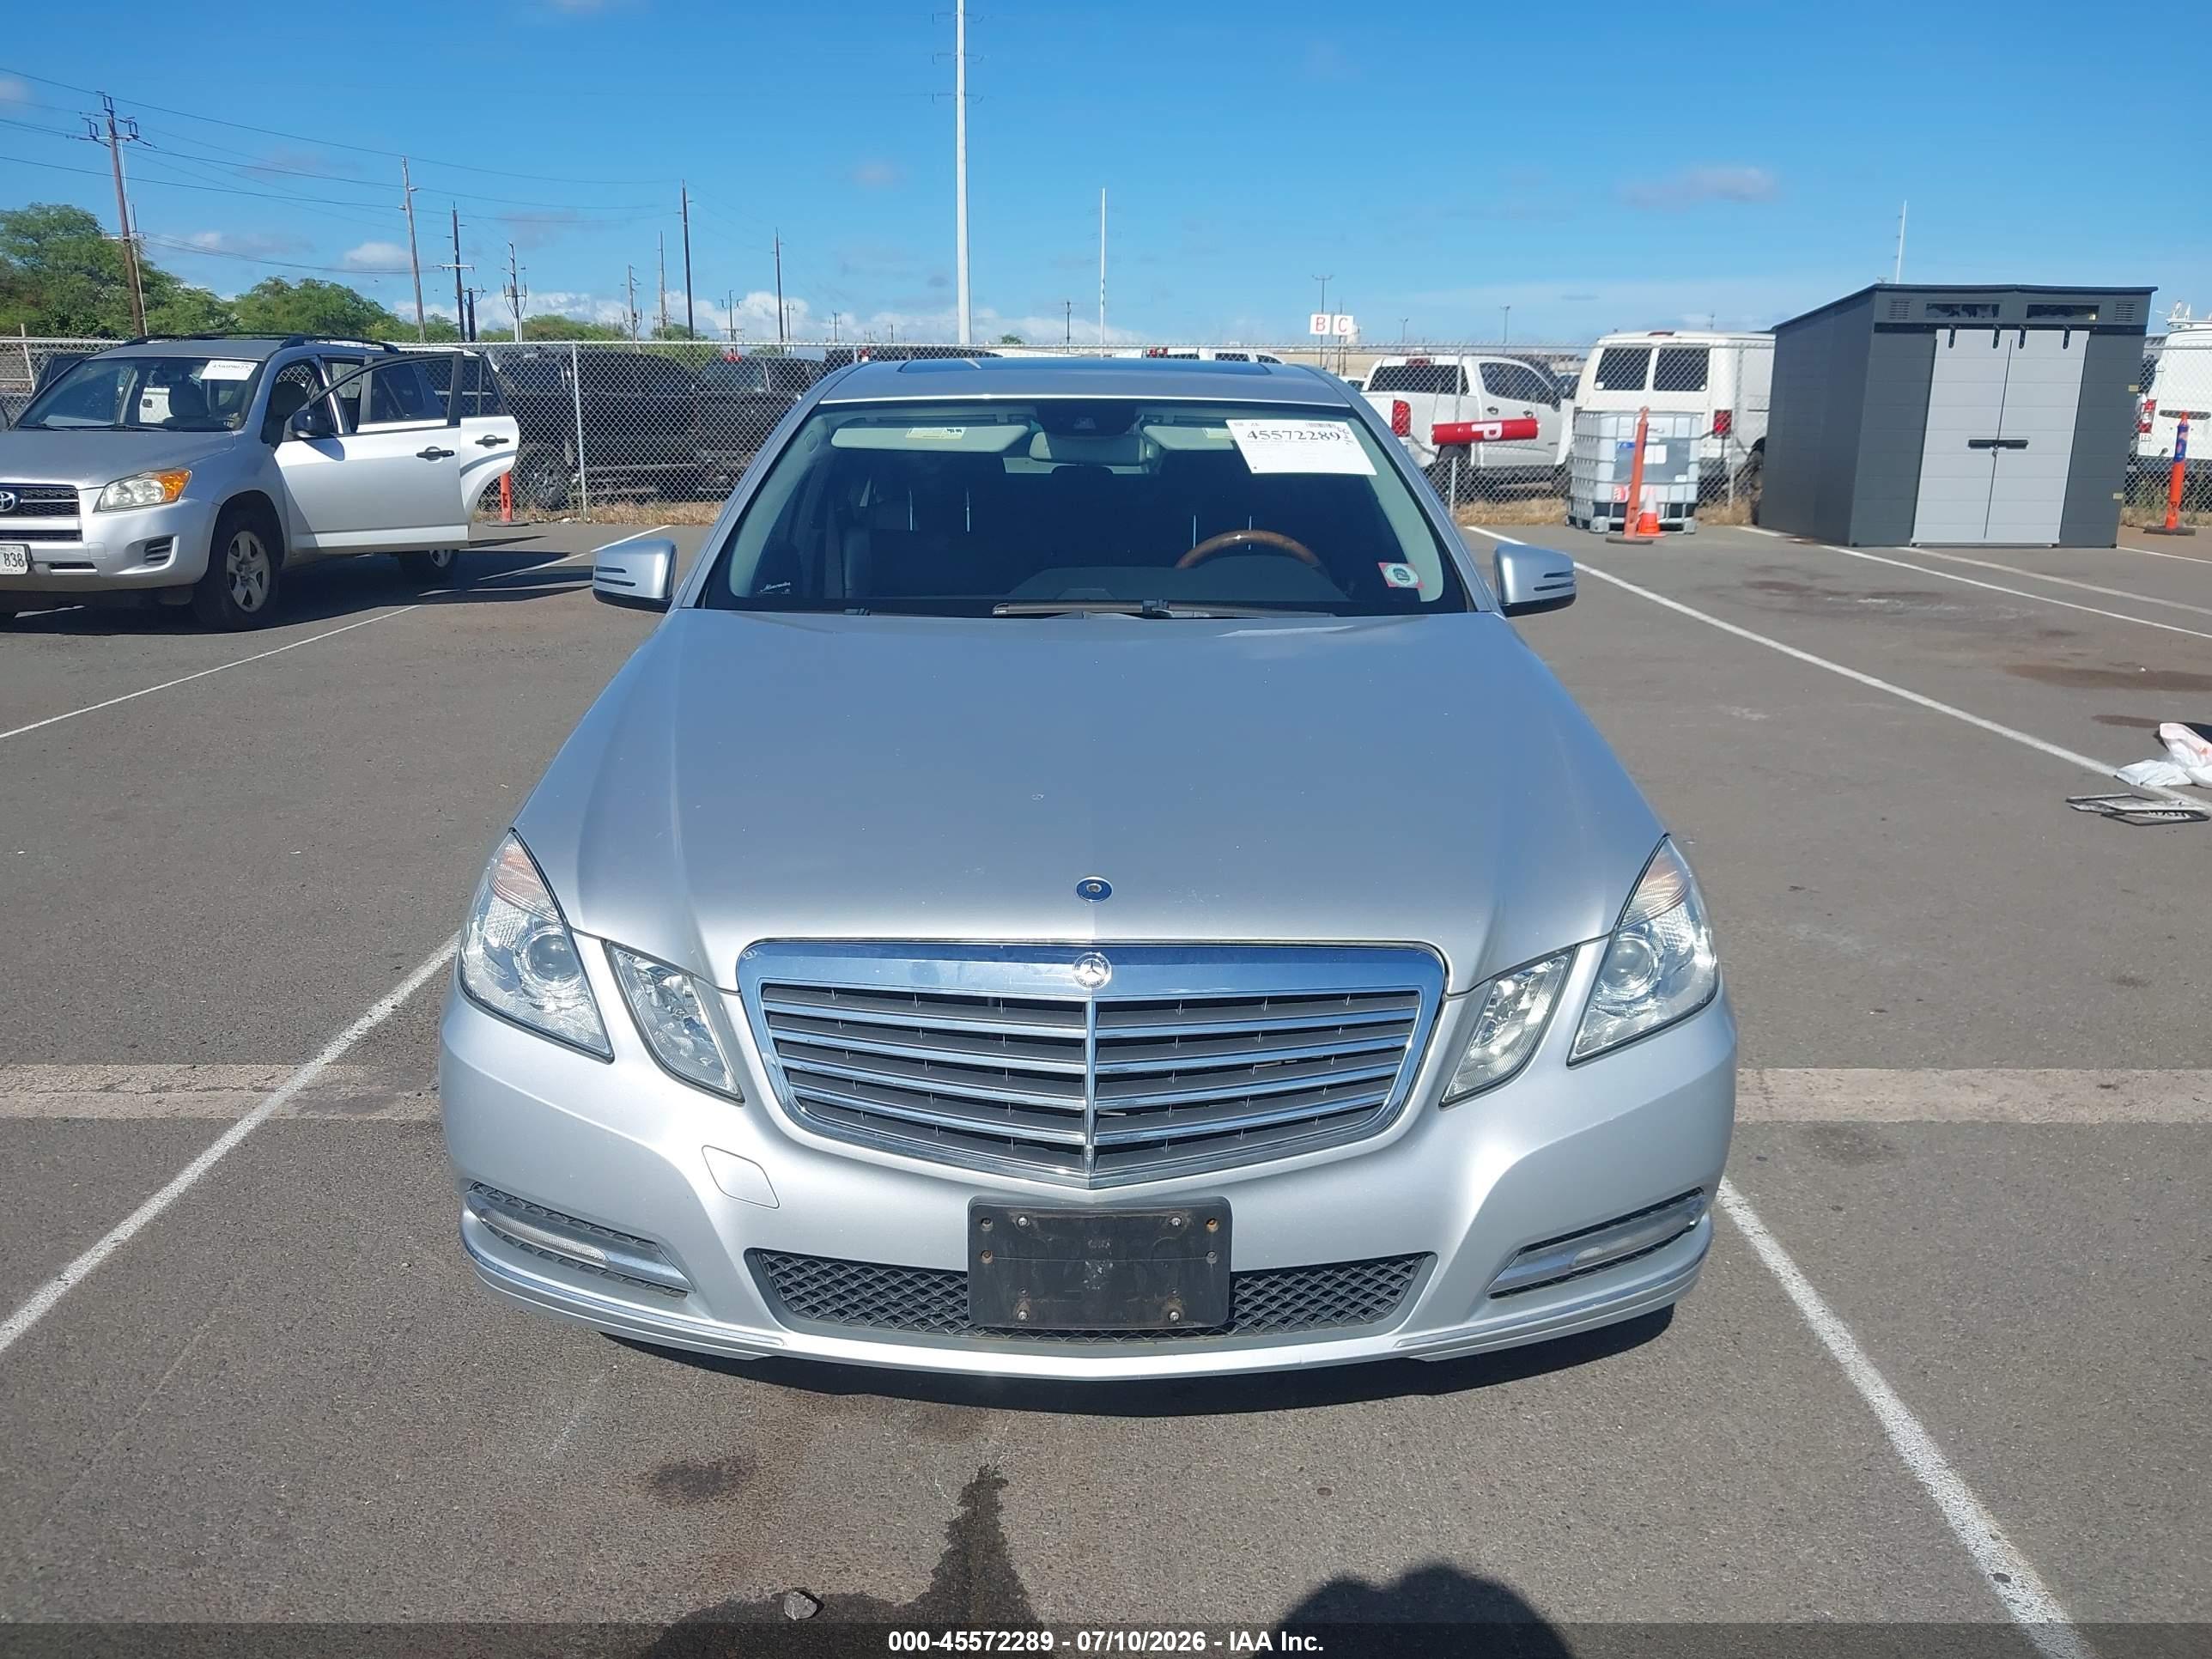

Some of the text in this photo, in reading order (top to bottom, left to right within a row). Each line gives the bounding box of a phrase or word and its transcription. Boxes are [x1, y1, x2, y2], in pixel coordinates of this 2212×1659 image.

[1316, 316, 1326, 331] B
[1338, 317, 1348, 332] C
[1247, 429, 1340, 441] 45572289
[1471, 422, 1503, 441] P
[3, 552, 25, 568] 838
